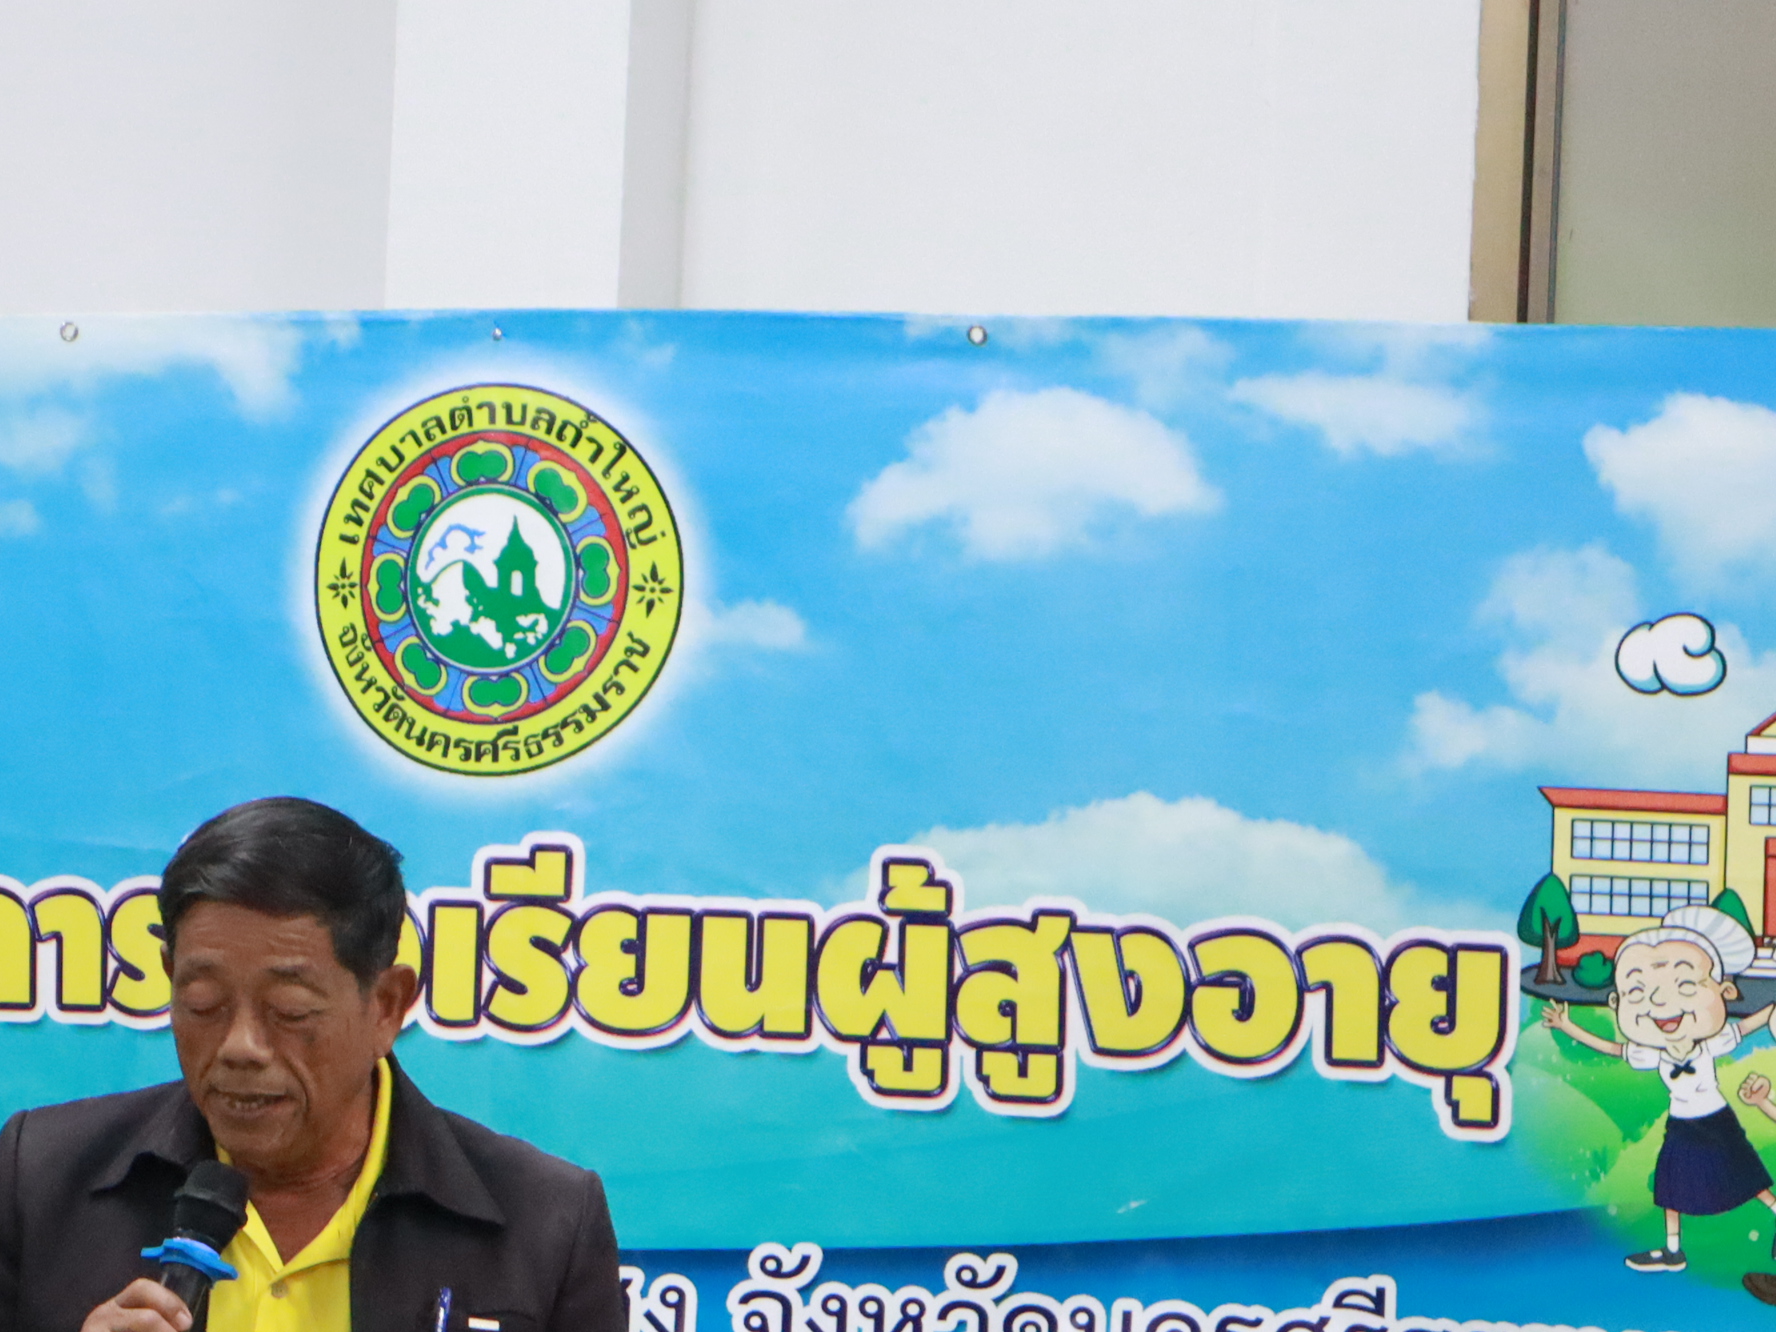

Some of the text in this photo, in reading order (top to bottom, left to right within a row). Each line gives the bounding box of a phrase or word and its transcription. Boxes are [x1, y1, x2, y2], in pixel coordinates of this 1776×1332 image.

[338, 396, 667, 550] เทศบาลตำบลถ้ำใหญ่
[338, 622, 652, 764] จังหวัดนครศรีธรรมราช
